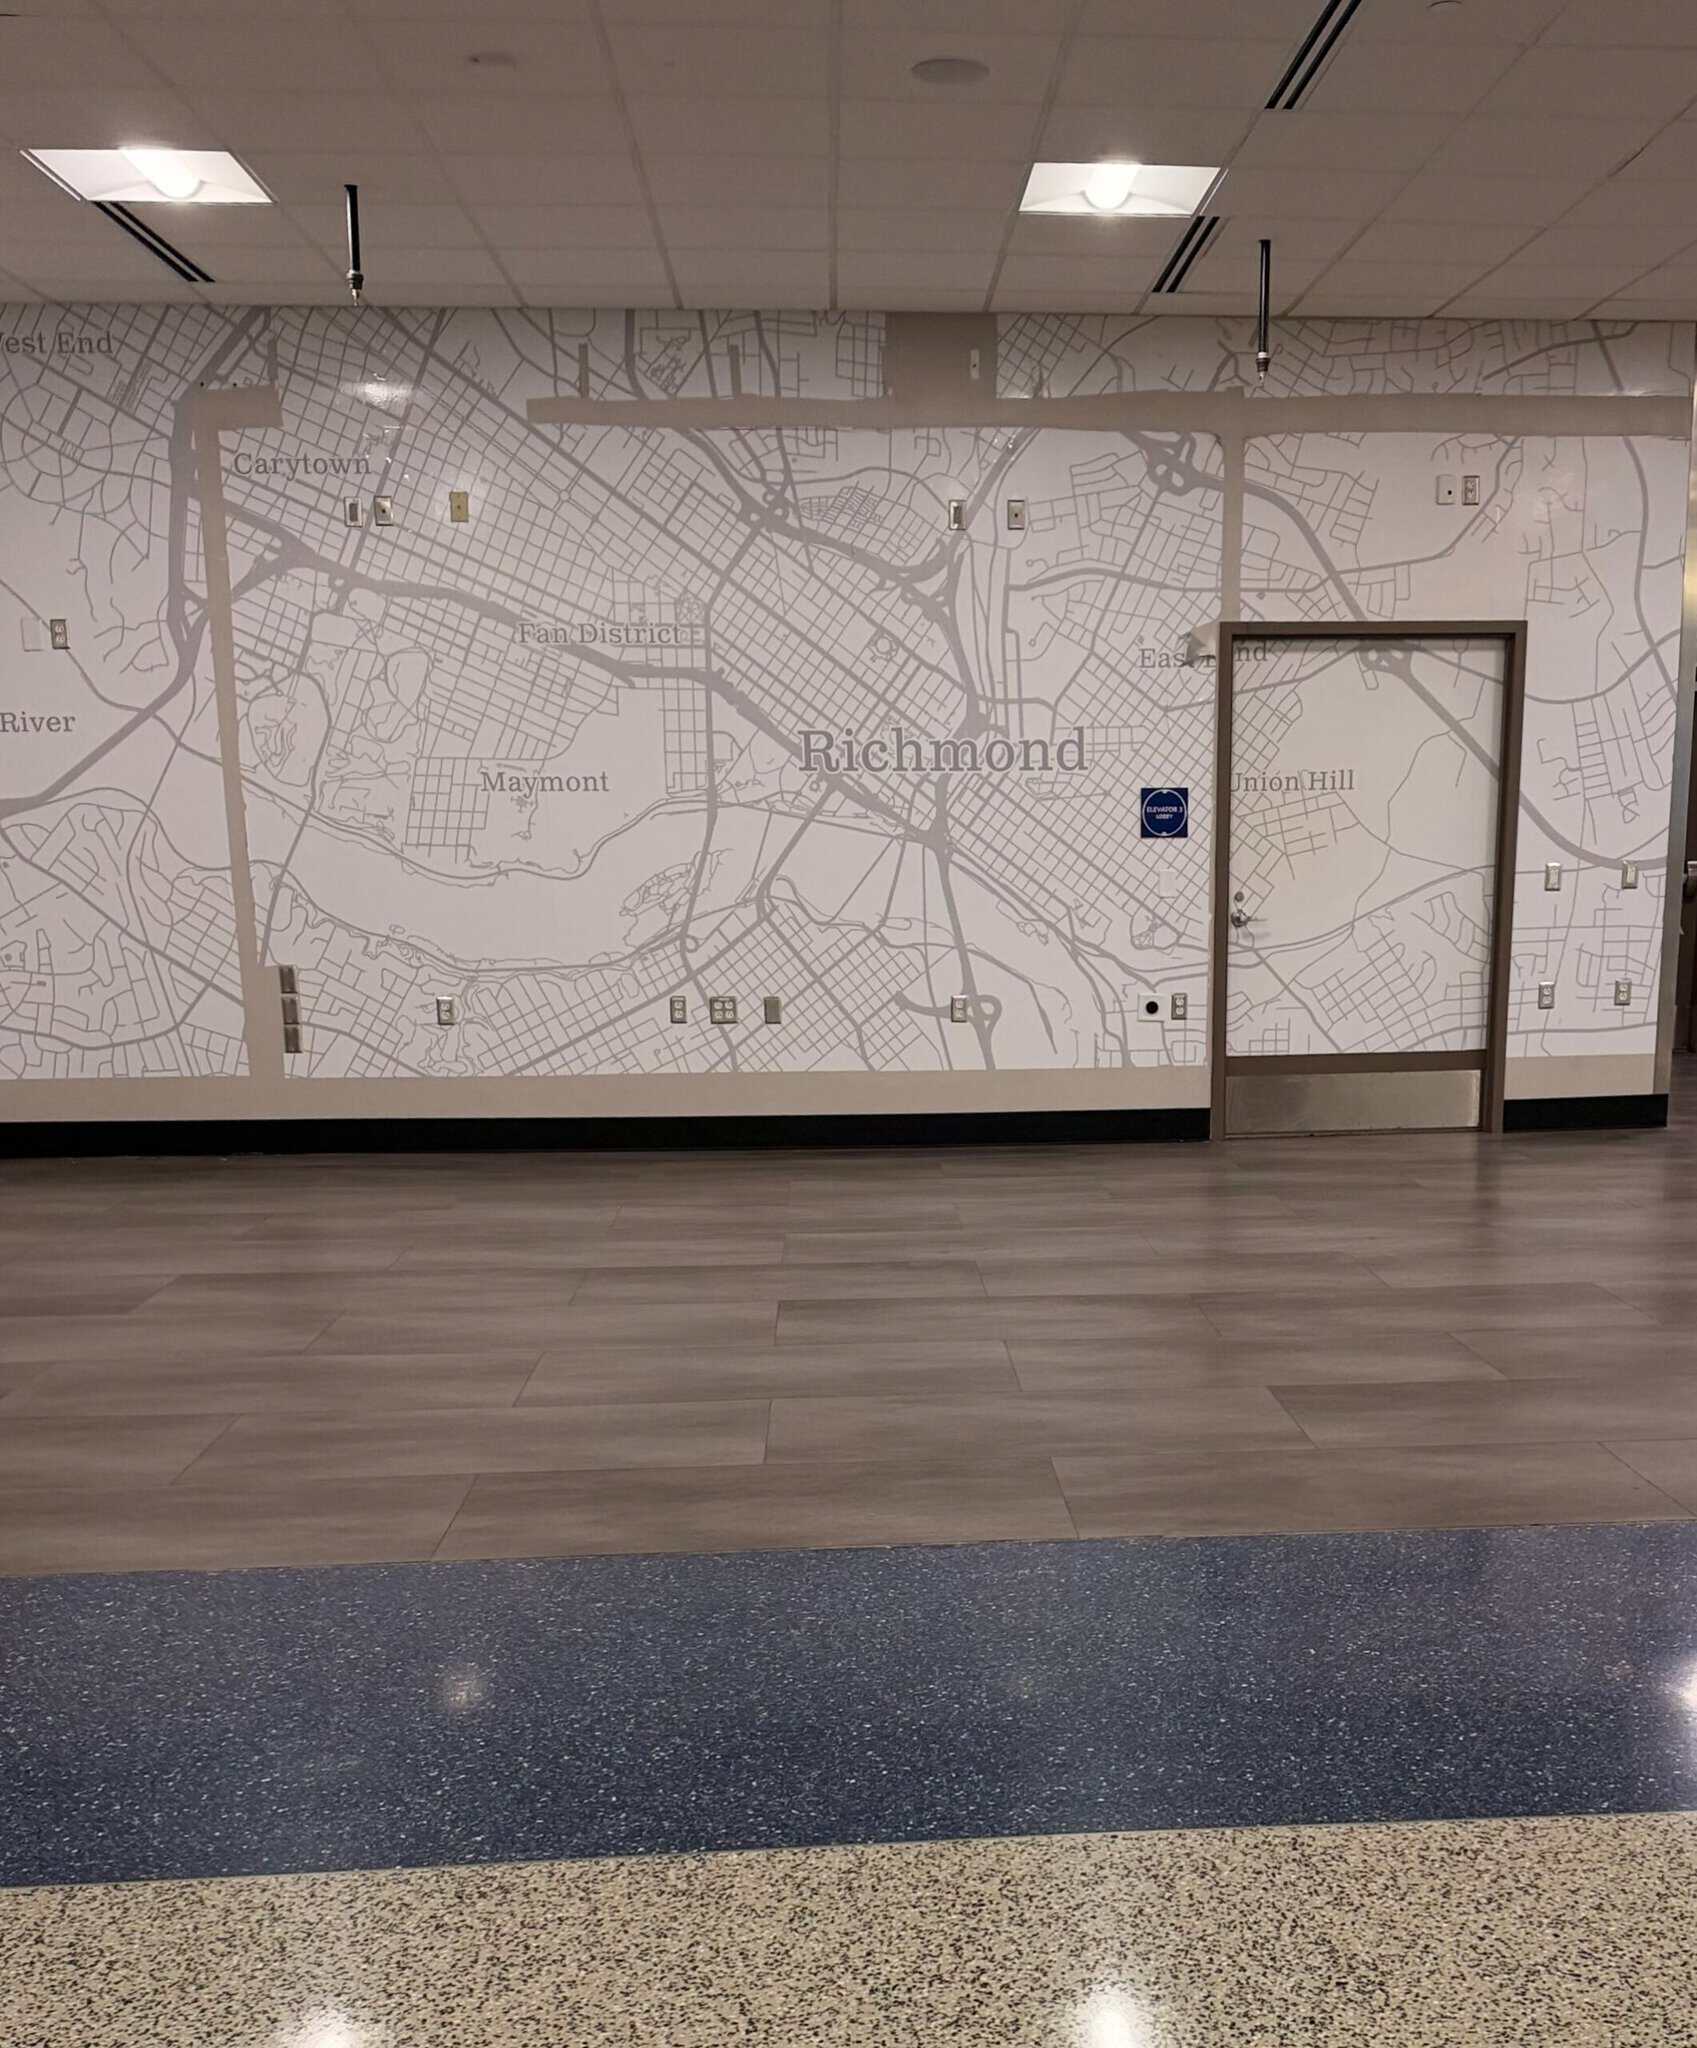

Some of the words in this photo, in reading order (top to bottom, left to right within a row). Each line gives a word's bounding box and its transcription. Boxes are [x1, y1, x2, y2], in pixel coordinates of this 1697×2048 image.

[0, 331, 47, 354] est
[58, 331, 113, 354] End
[233, 452, 372, 481] Carytown
[518, 623, 569, 644] Fan
[577, 623, 682, 644] District
[1139, 648, 1197, 669] Eas
[0, 711, 76, 733] River
[798, 727, 1089, 772] Richmond
[480, 771, 610, 799] Maymont
[1307, 769, 1355, 791] Hill
